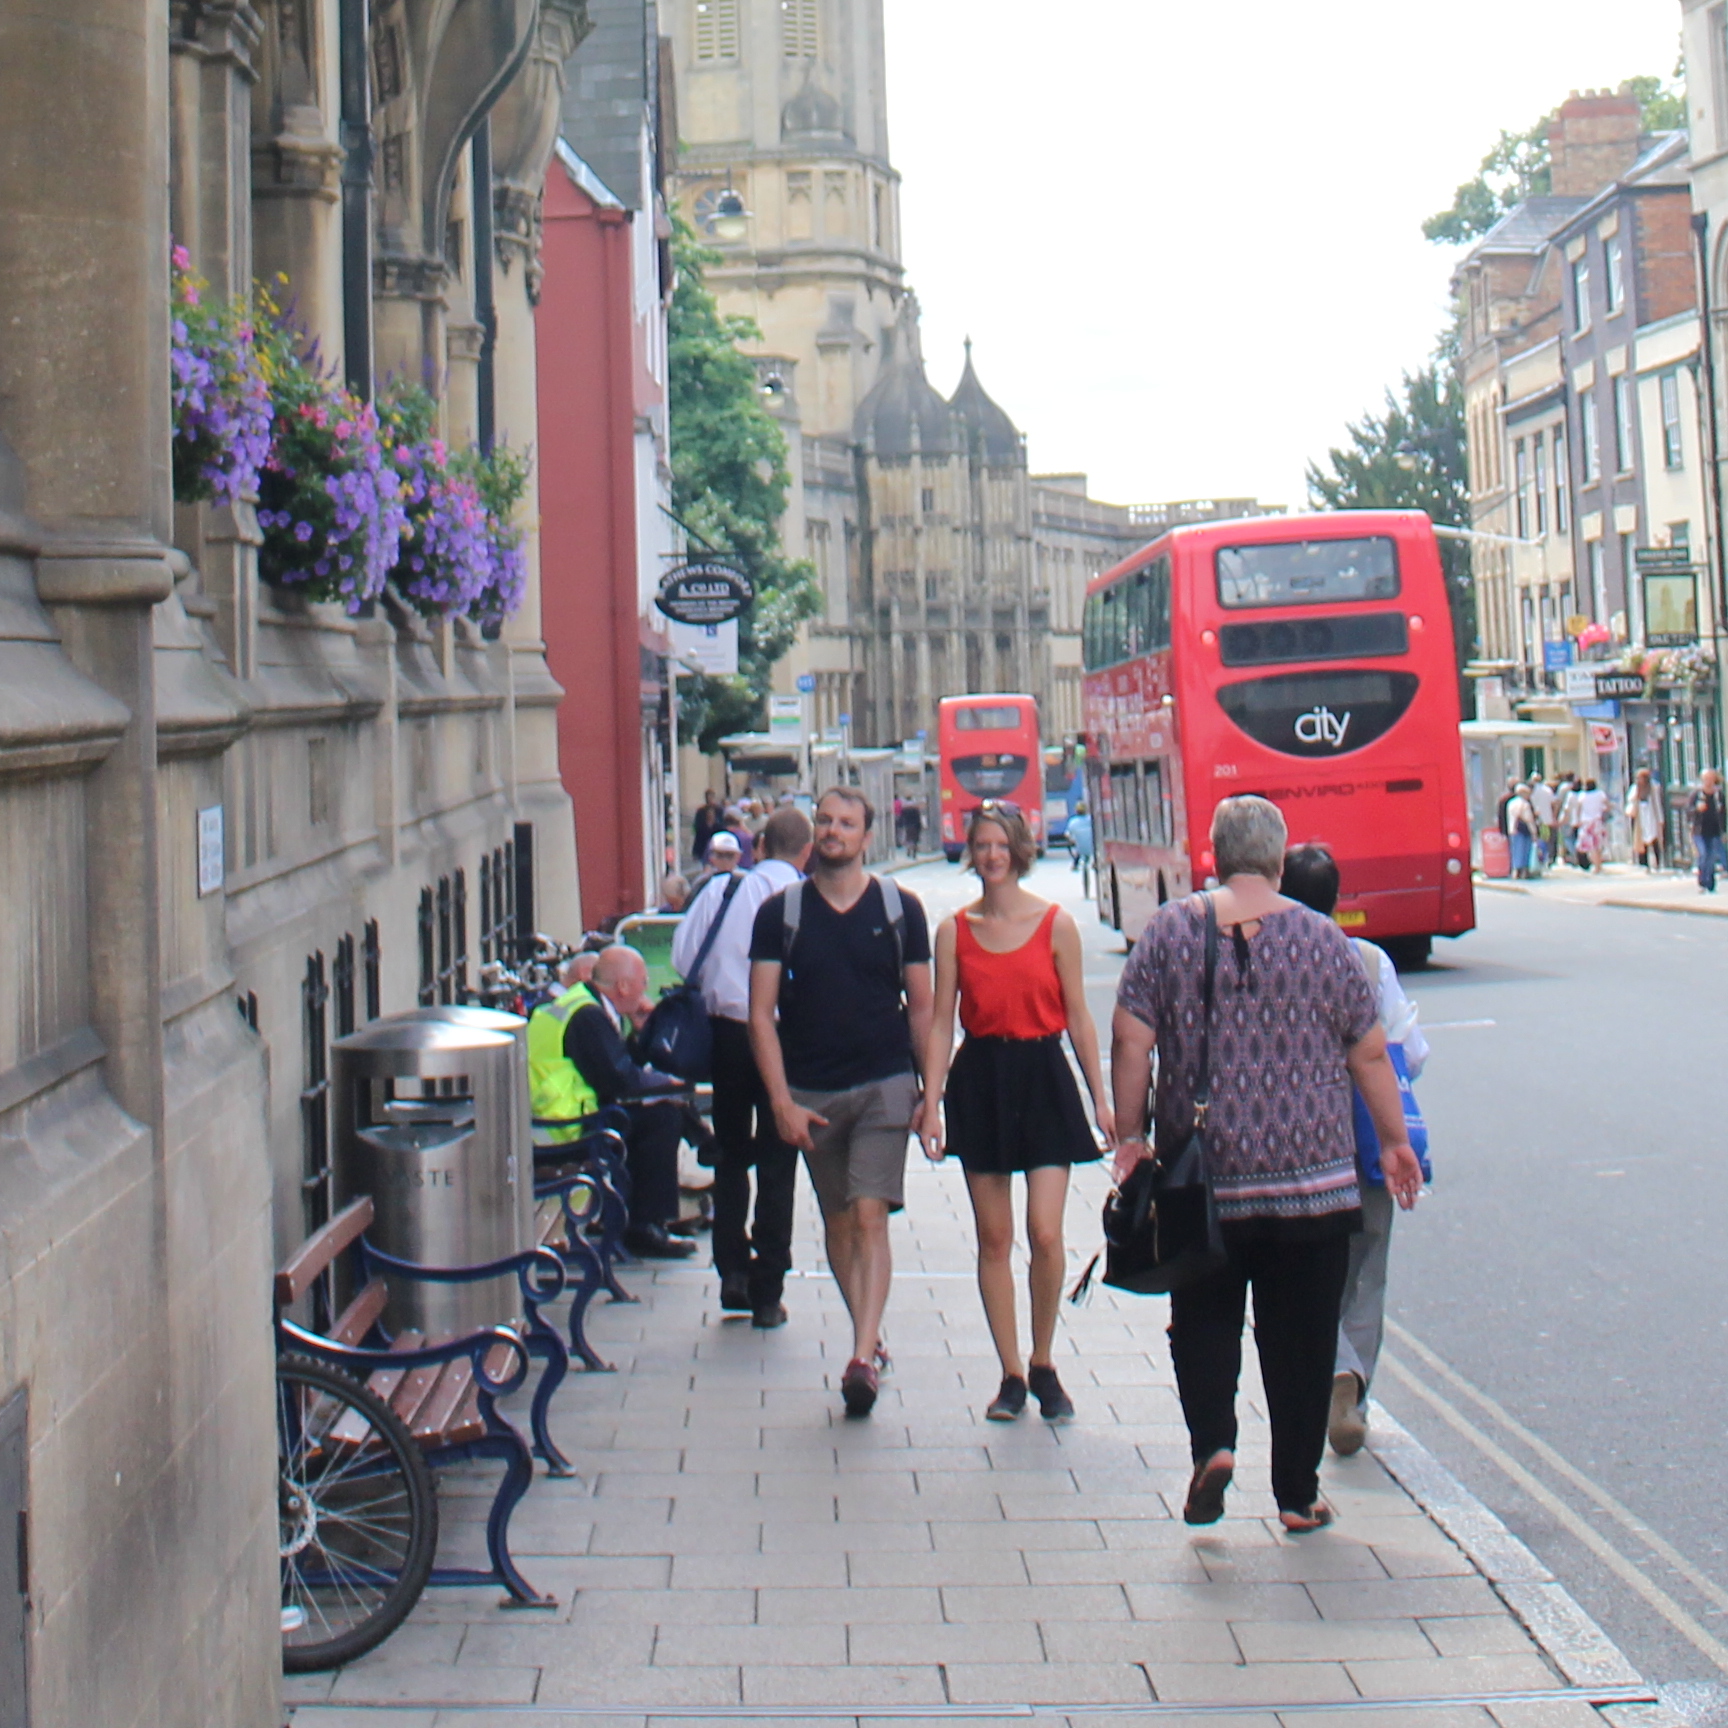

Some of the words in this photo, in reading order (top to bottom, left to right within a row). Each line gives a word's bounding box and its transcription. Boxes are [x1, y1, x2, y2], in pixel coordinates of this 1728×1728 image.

[1598, 677, 1642, 694] TATTOO
[1294, 705, 1351, 747] city
[1214, 764, 1238, 777] 201
[1270, 783, 1355, 800] ENVIRO
